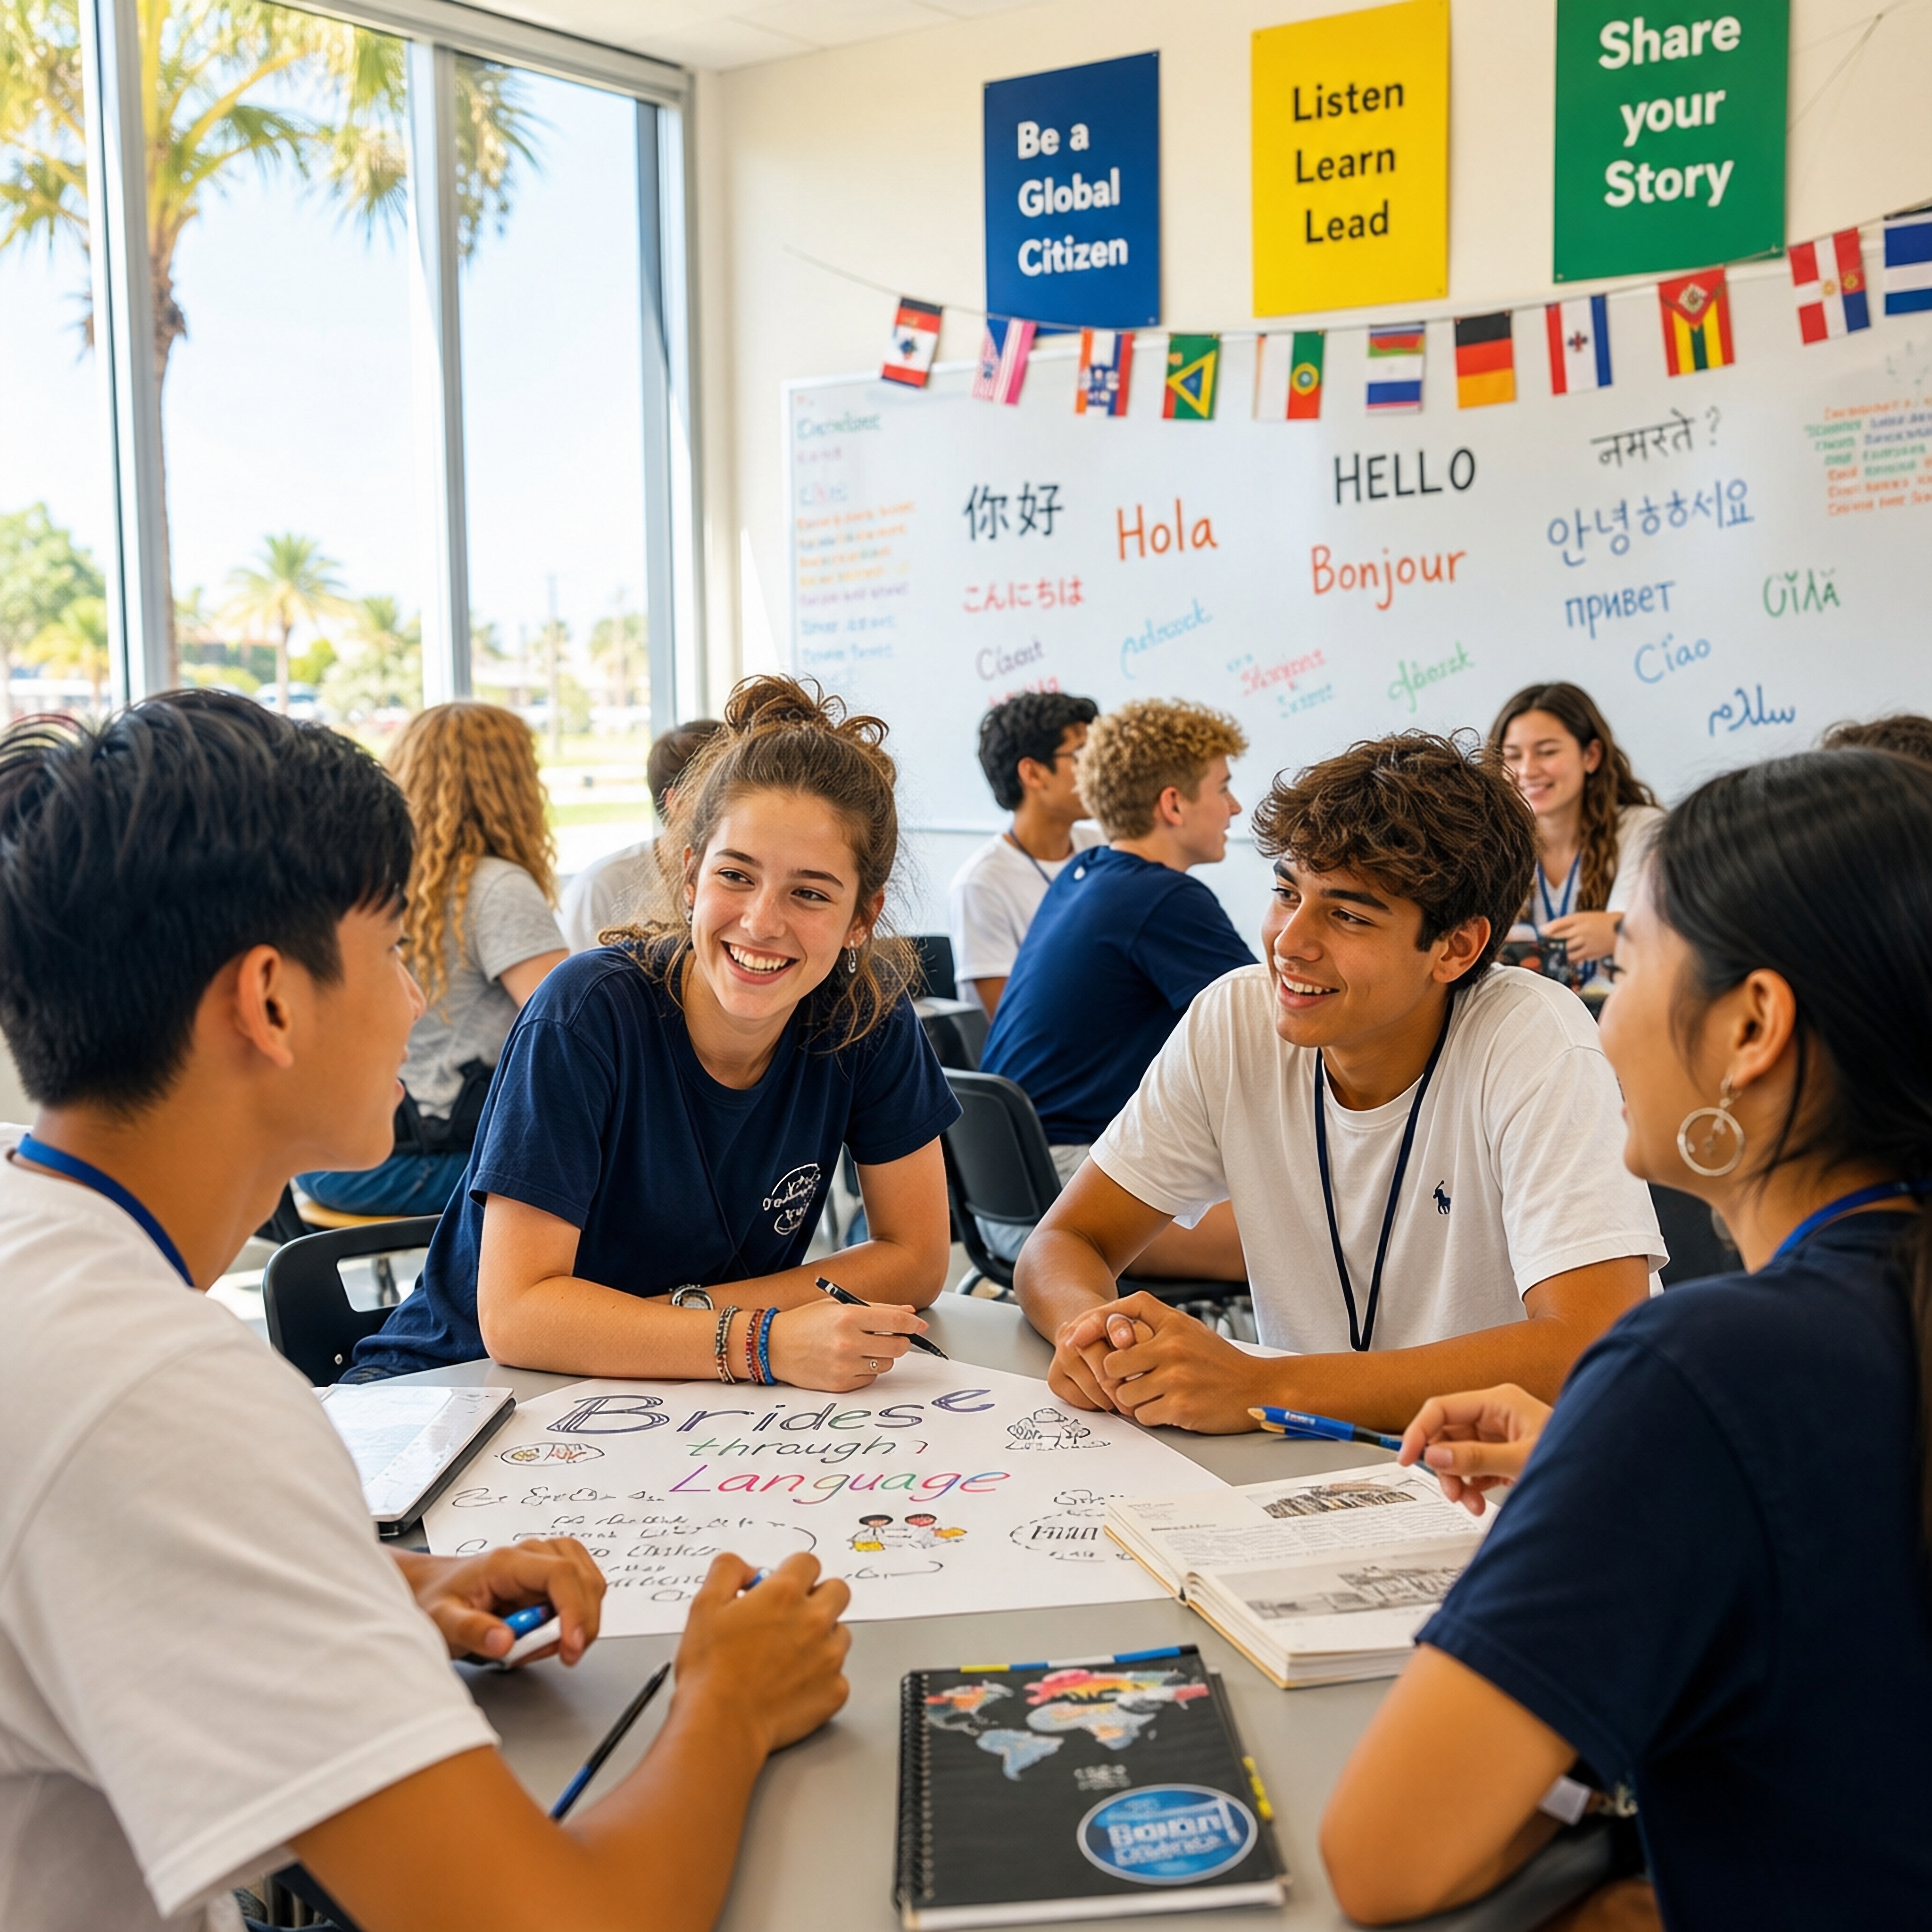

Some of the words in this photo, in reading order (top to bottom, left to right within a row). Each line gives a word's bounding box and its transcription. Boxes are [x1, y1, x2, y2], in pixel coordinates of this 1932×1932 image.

[1599, 16, 1741, 69] Share
[1293, 83, 1404, 123] Listen
[1620, 90, 1726, 147] your
[1017, 121, 1060, 159] Be
[1069, 123, 1089, 151] a
[1296, 148, 1396, 184] Learn
[1604, 160, 1734, 207] Story
[1018, 167, 1120, 217] Global
[1306, 199, 1389, 244] Lead
[1018, 234, 1128, 276] Citizen
[1334, 447, 1476, 505] HELLO
[964, 482, 1063, 541] 你好
[1117, 498, 1218, 561] Hola
[963, 575, 1084, 613] こんにちは
[1311, 545, 1466, 611] Bonjour
[1565, 580, 1676, 640] привет
[1709, 684, 1796, 737] سلام
[669, 1464, 1011, 1505] Language
